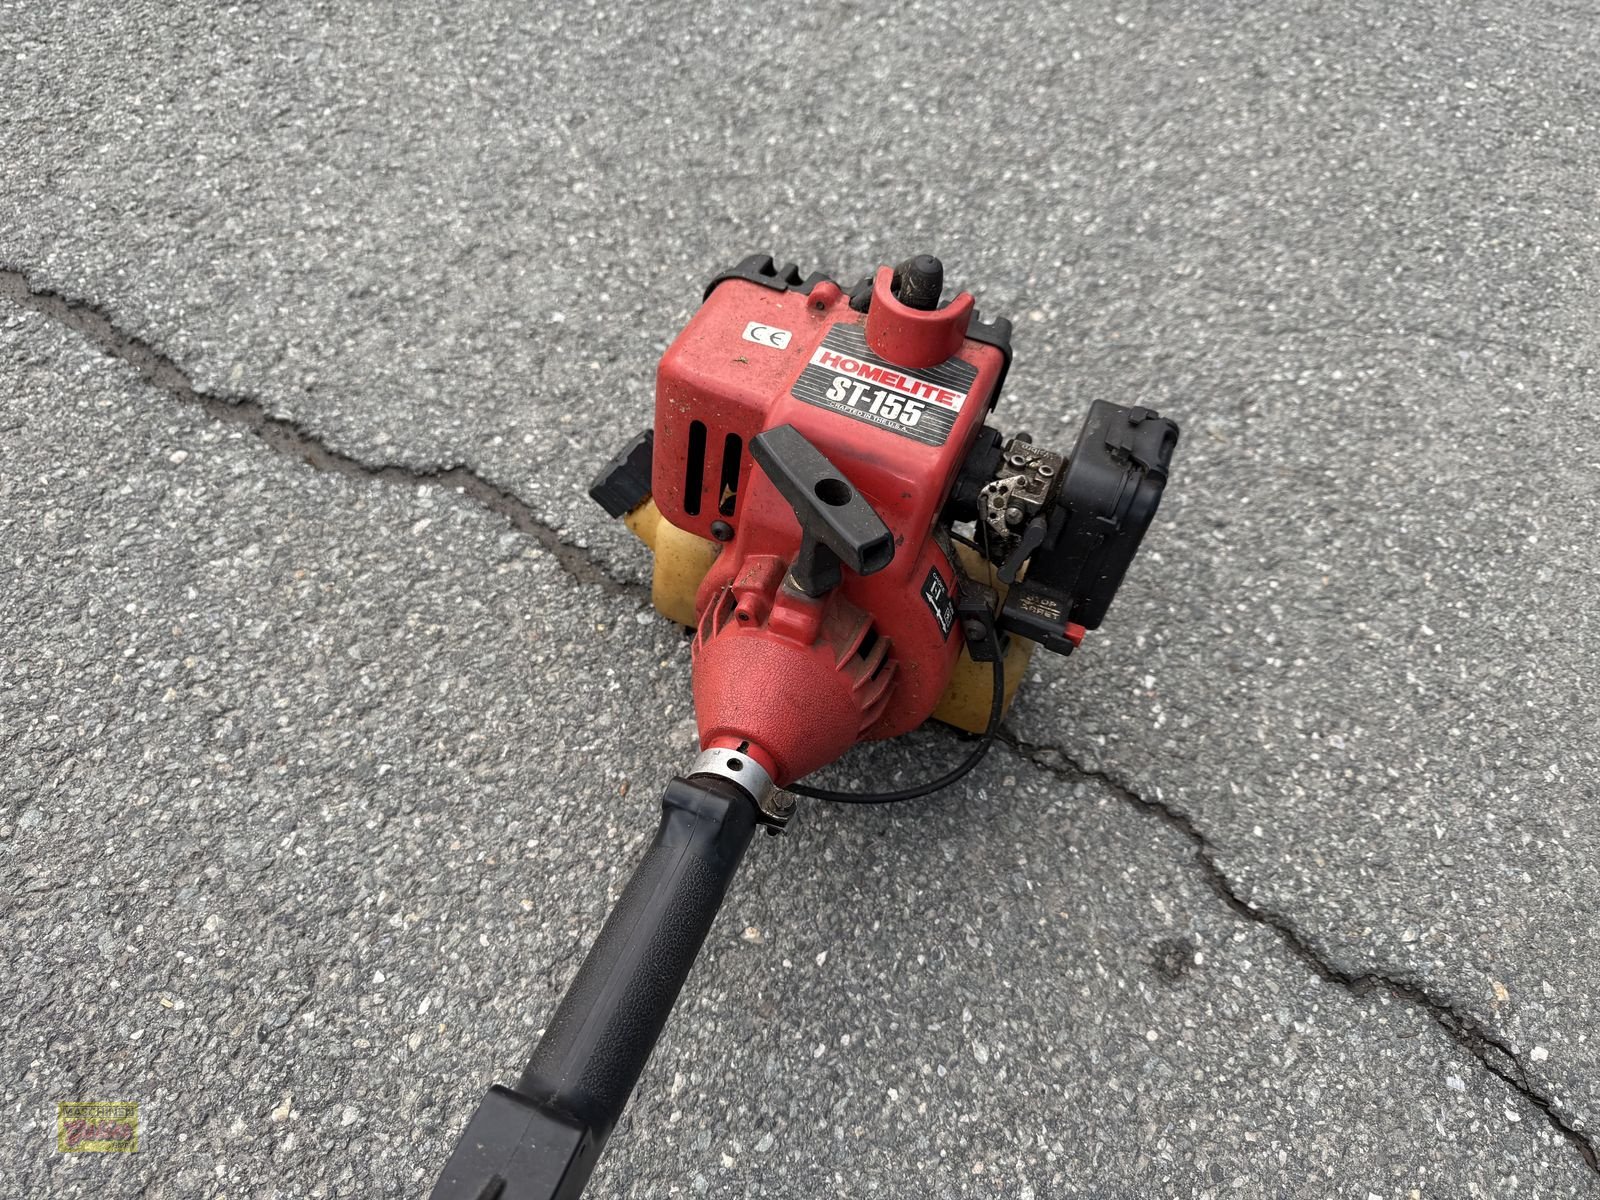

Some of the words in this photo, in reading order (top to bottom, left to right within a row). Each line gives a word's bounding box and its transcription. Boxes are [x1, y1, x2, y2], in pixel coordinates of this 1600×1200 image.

[750, 326, 786, 346] CE
[819, 351, 958, 407] HOMELITE
[826, 376, 927, 427] ST-155
[829, 401, 863, 417] CRAFTED
[863, 412, 872, 420] IN
[873, 415, 887, 425] THE
